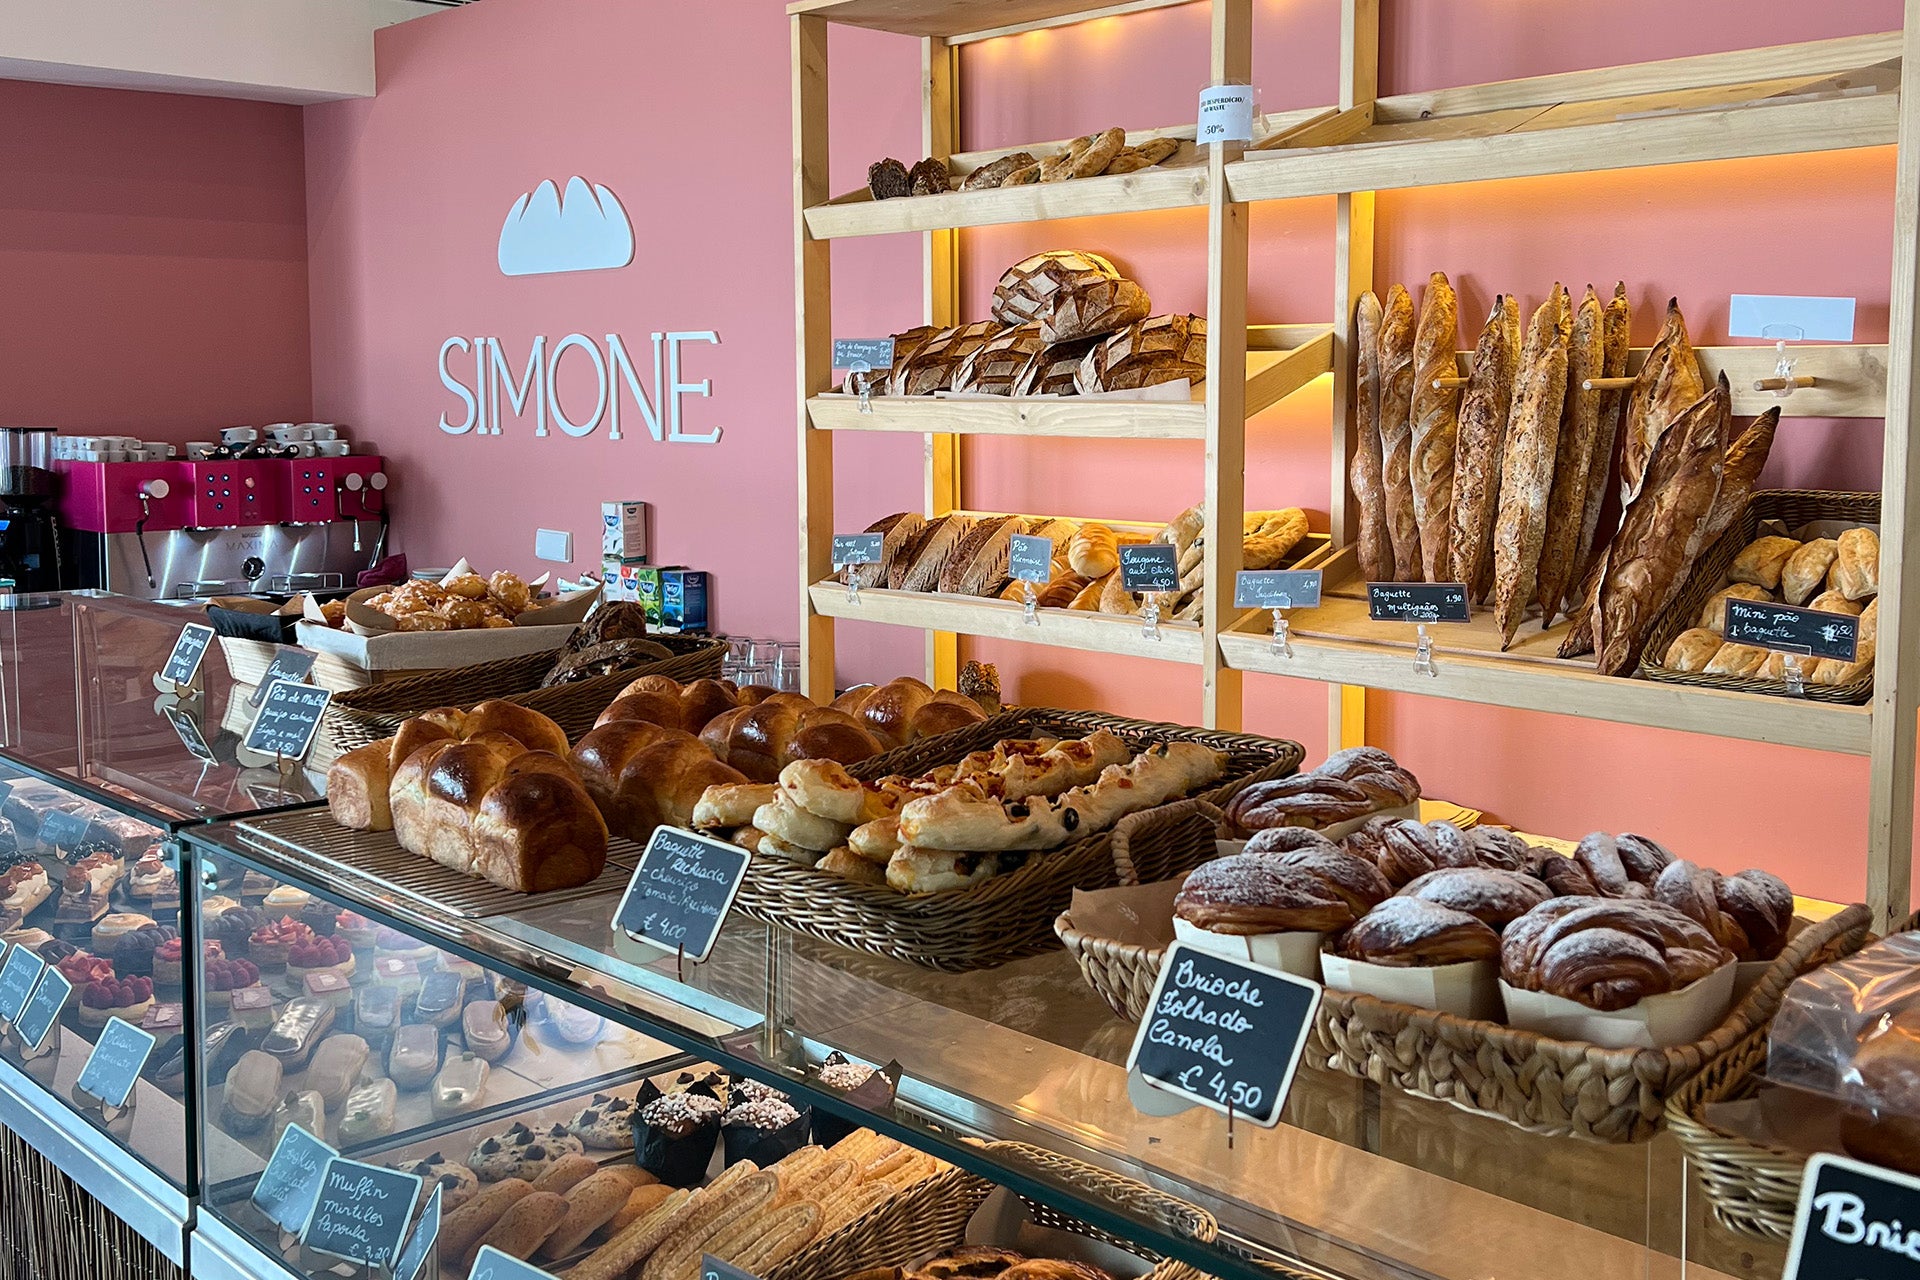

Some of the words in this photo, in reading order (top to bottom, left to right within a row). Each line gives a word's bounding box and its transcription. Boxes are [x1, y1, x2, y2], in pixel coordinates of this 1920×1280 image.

[438, 330, 723, 444] SIMONE
[225, 541, 278, 551] MAXIA
[1373, 588, 1411, 602] Baguette
[269, 685, 288, 702] Pão
[653, 833, 706, 860] Baguette
[670, 858, 729, 885] Recheada
[660, 917, 687, 939] 4,00
[1174, 959, 1264, 1008] Brioche
[1156, 989, 1253, 1034] Folhado
[1149, 1018, 1234, 1067] Canela
[1209, 1071, 1263, 1109] 4,50
[329, 1171, 389, 1201] Muffin
